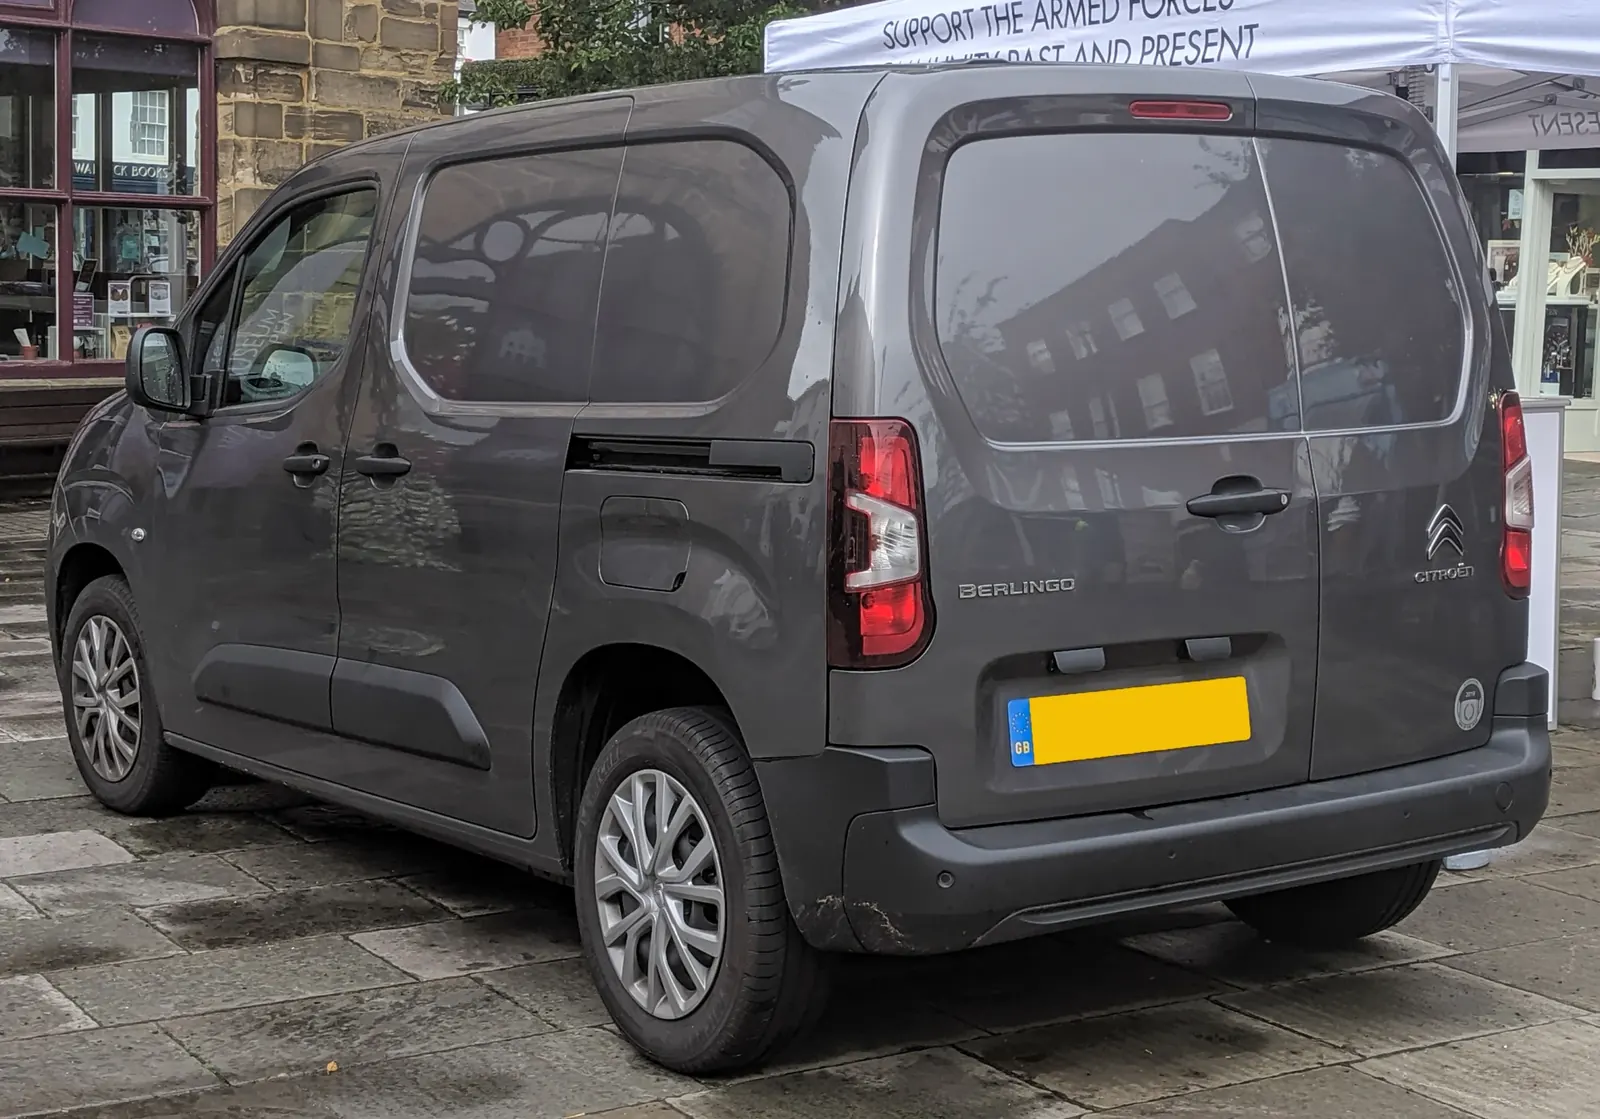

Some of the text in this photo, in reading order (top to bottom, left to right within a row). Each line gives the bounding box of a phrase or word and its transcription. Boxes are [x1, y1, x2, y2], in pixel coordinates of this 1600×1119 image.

[883, 8, 974, 49] SUPPORT
[980, 1, 1023, 37] THE
[1031, 0, 1119, 31] ARMED
[1075, 39, 1132, 64] AND
[1139, 23, 1259, 66] PRESENT
[74, 162, 168, 179] WACK BOOKS
[229, 308, 280, 373] USEUM
[268, 312, 295, 345] PEN
[959, 578, 1075, 599] BERLINGO
[1015, 741, 1030, 755] GB
